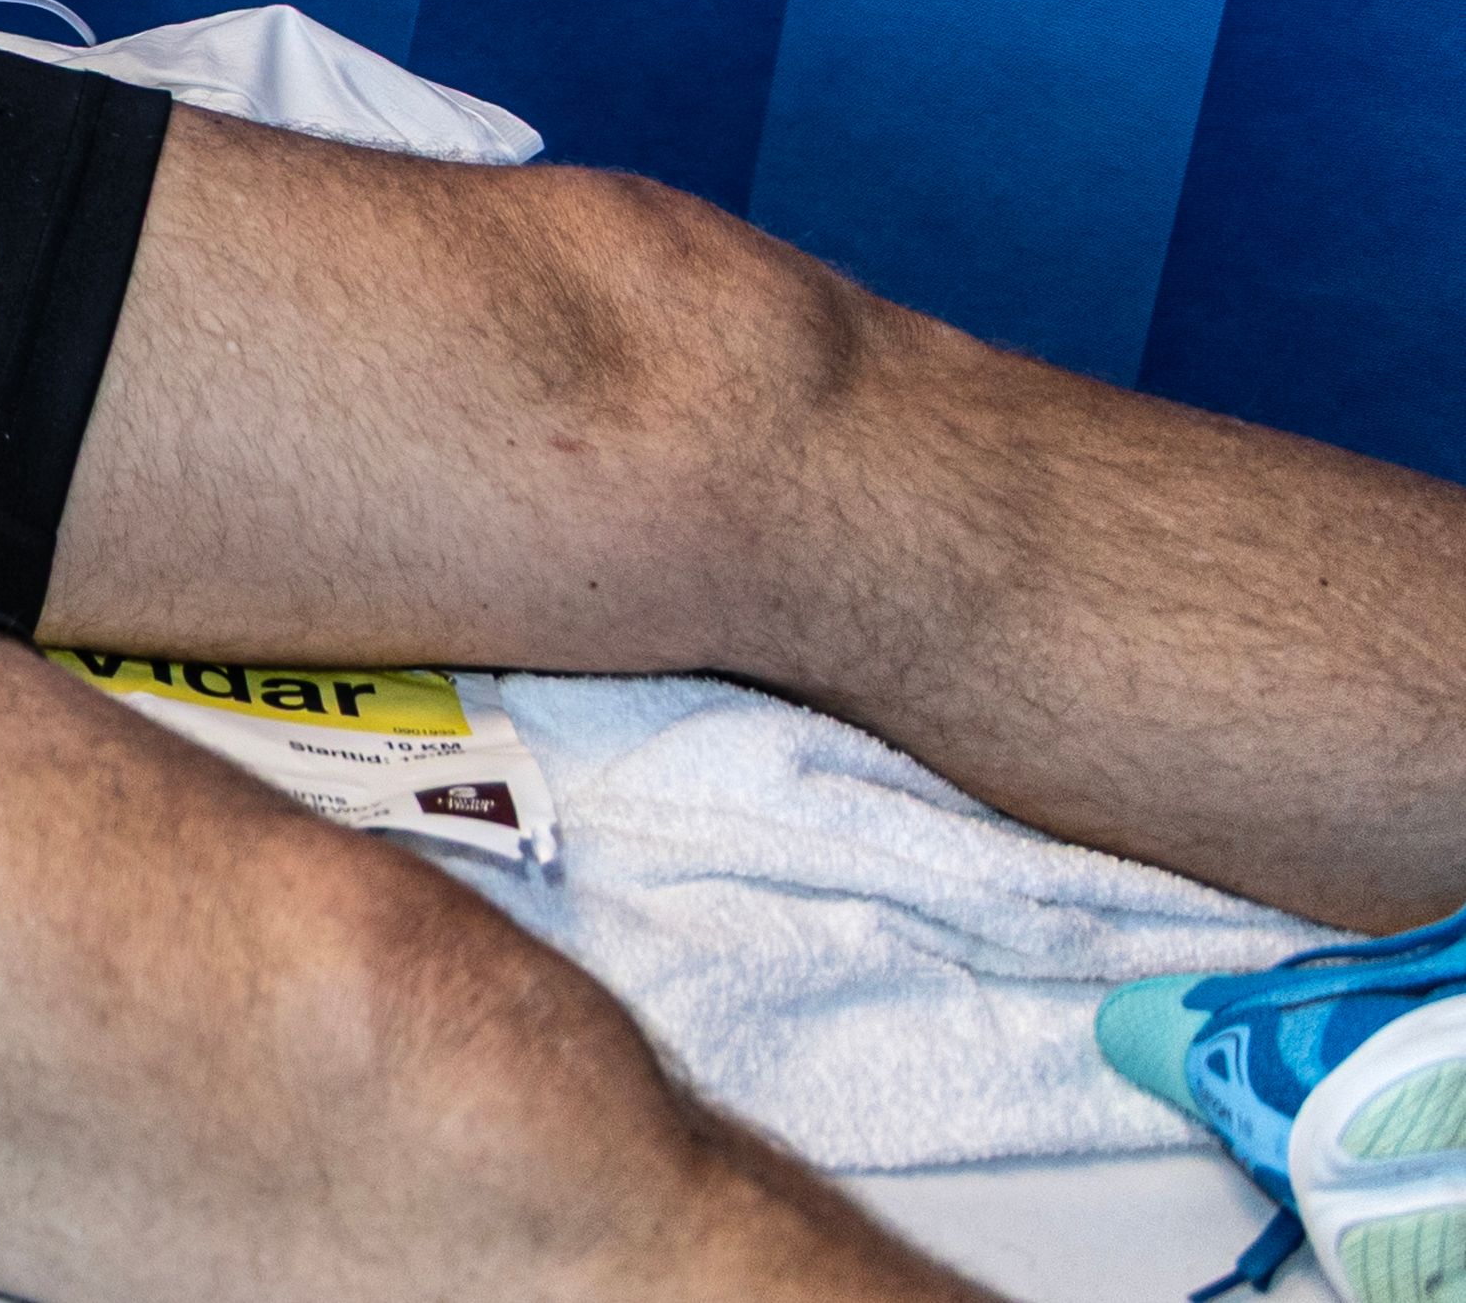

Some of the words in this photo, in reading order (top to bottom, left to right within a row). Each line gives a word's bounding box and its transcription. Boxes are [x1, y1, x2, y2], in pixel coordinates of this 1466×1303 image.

[288, 739, 391, 765] Starttid:
[385, 741, 414, 752] 10
[421, 741, 463, 752] KM
